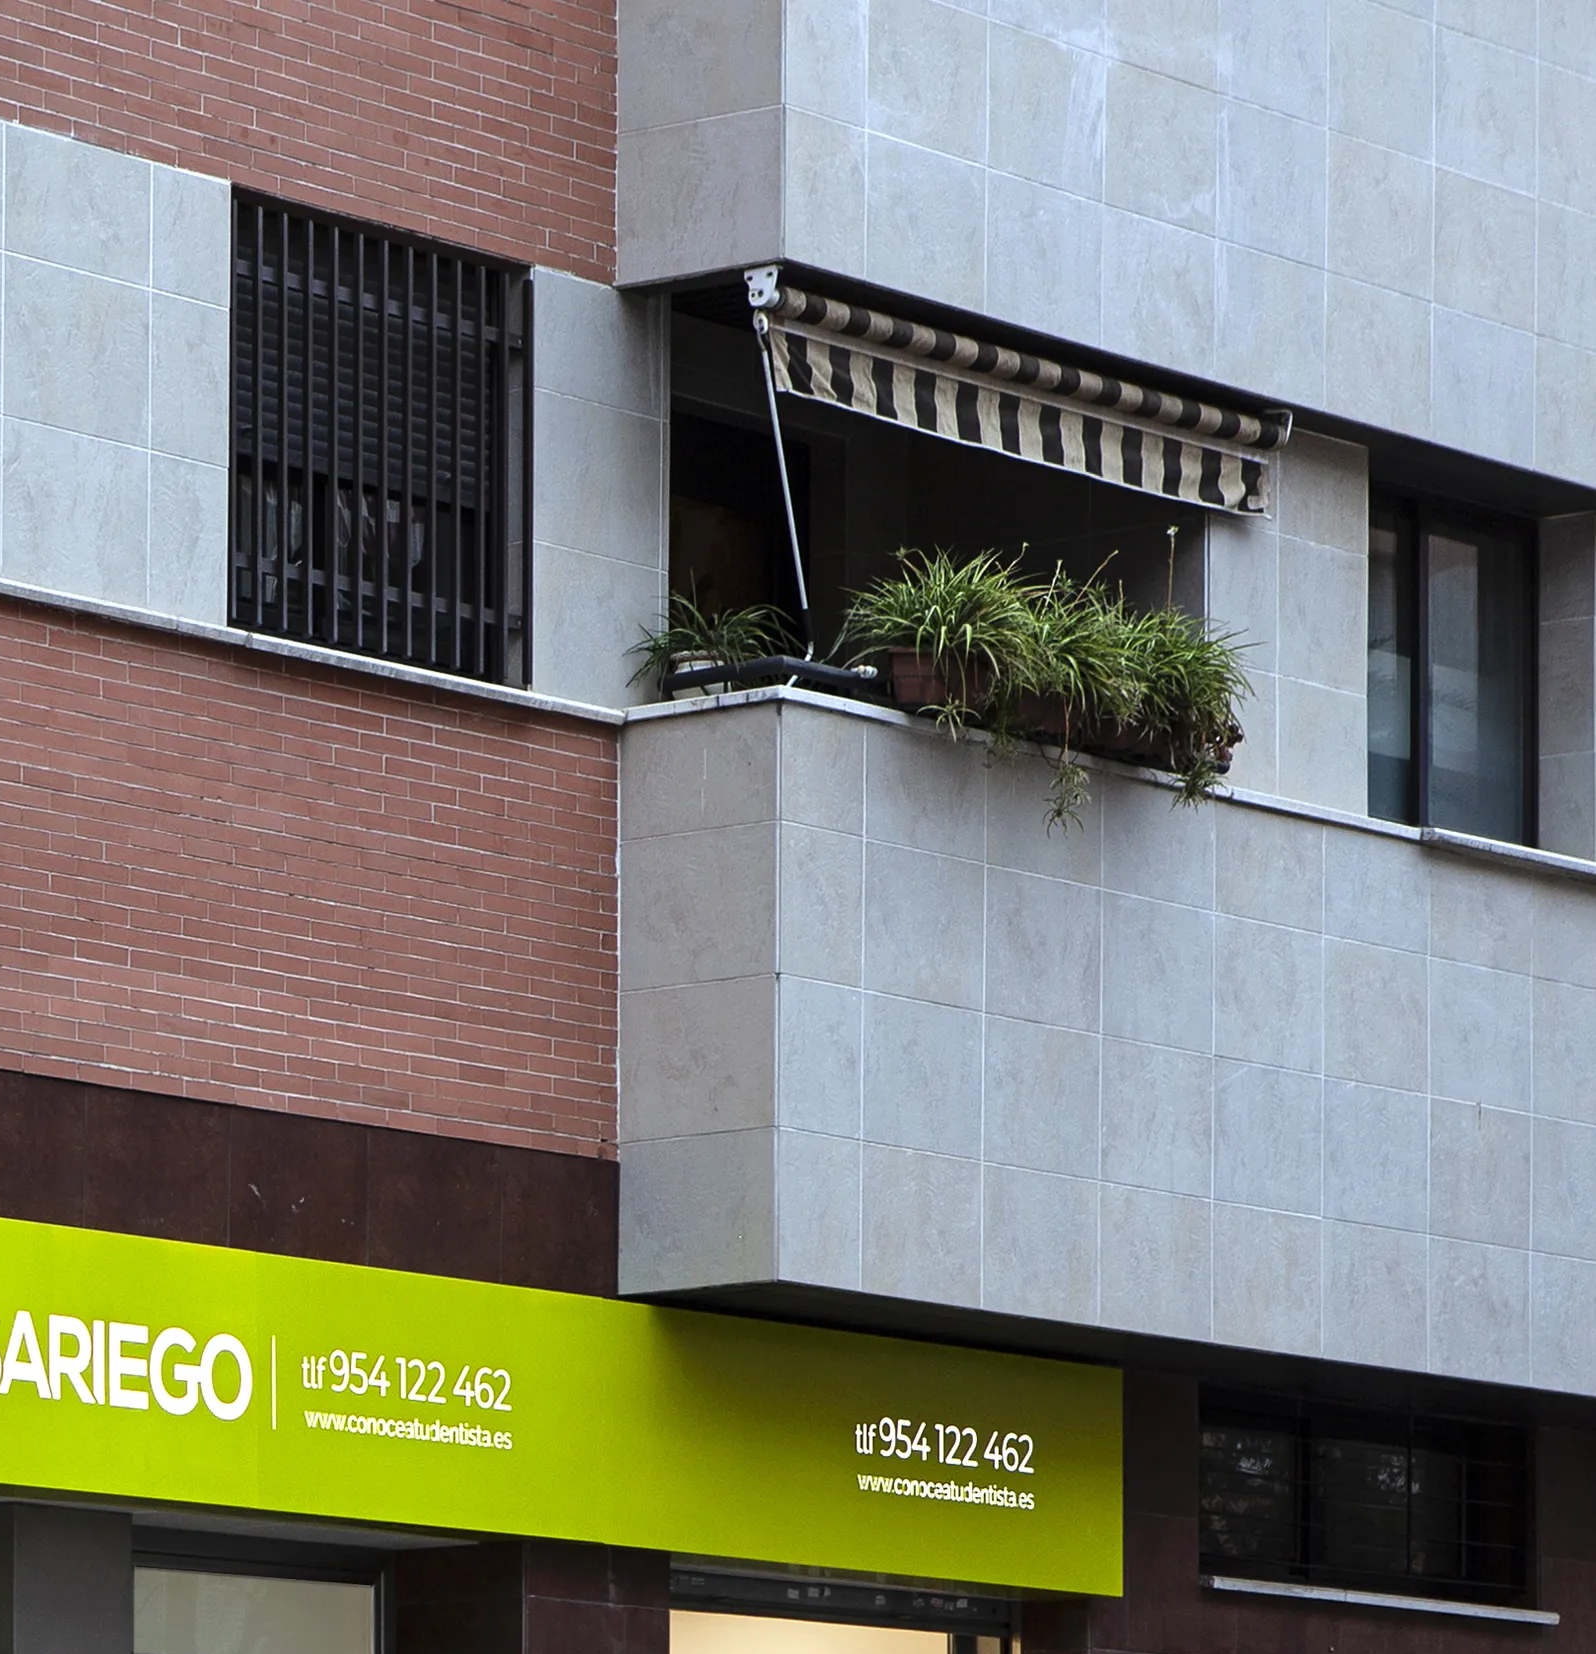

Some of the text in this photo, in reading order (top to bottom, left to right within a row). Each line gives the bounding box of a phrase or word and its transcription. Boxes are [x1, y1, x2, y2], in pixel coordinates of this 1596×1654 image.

[301, 1349, 512, 1412] tlf 954 122 462
[304, 1411, 513, 1450] www.conoceatudentista.es
[854, 1417, 1035, 1474] tlf 954 122 462
[857, 1474, 1035, 1510] www.conoceatudentista.es
